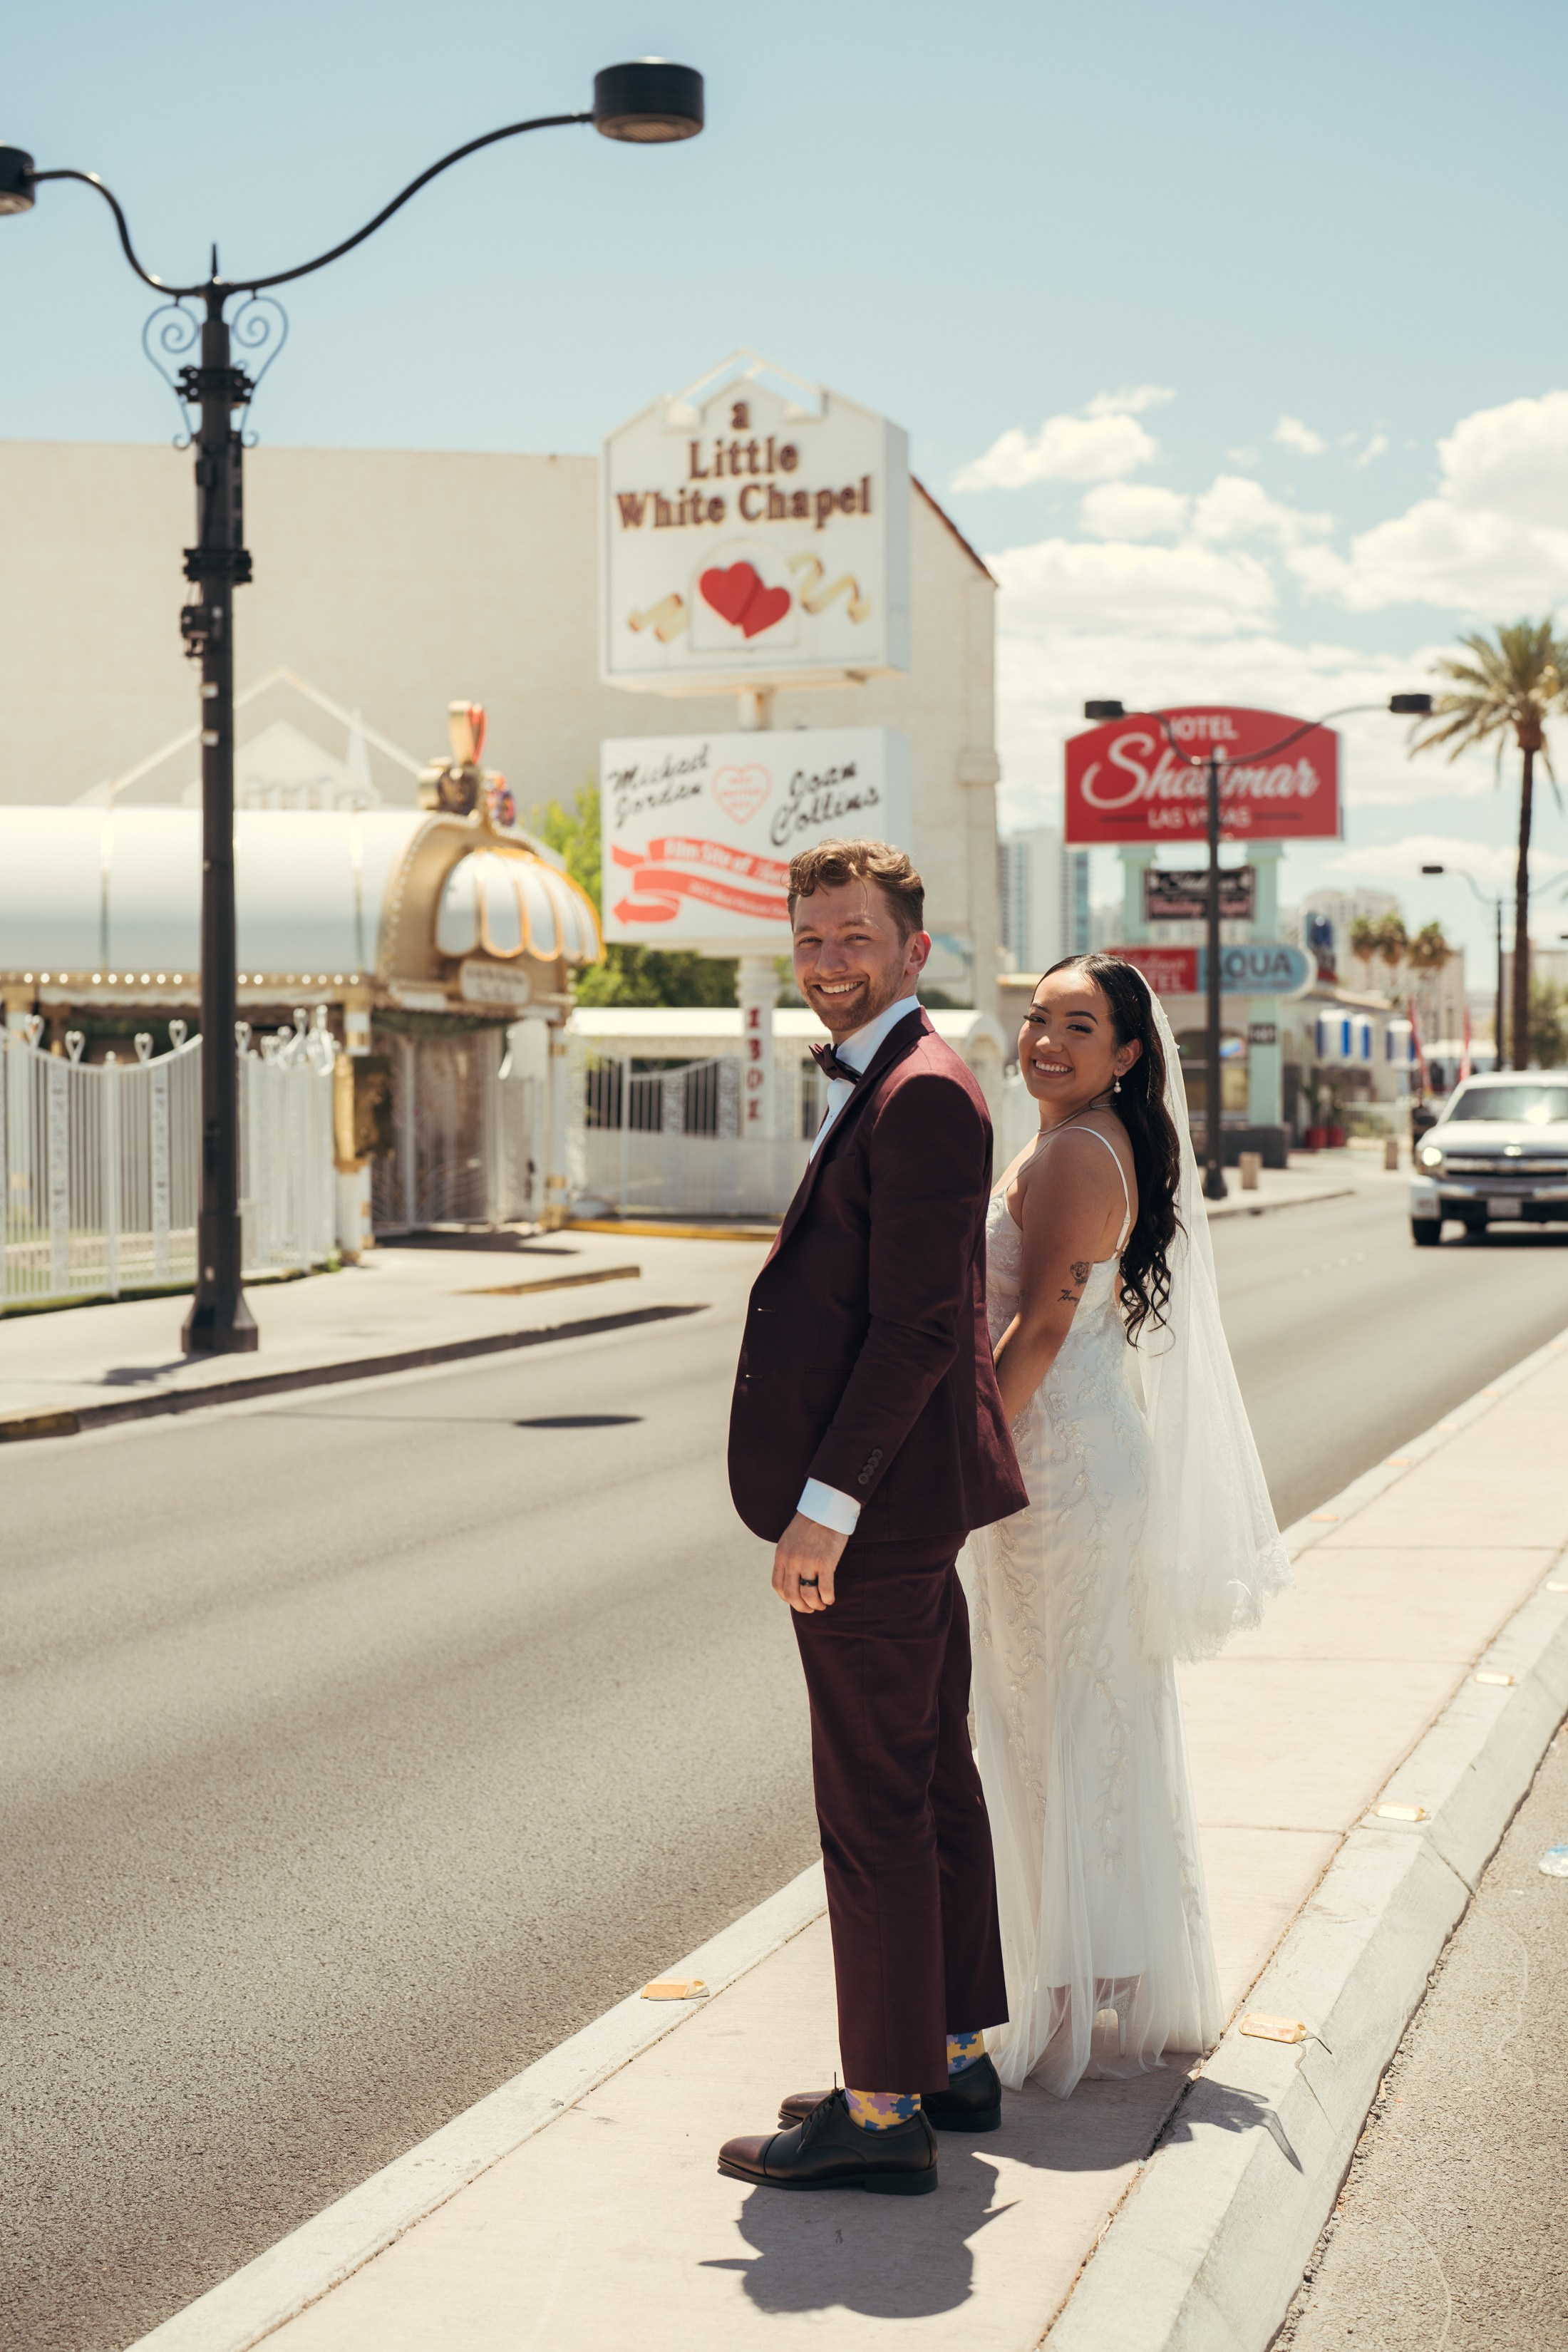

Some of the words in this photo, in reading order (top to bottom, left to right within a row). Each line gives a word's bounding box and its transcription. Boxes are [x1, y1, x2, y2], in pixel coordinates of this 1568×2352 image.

[732, 401, 750, 430] a
[688, 436, 799, 479] Little
[617, 488, 726, 528] White
[739, 475, 870, 530] Chapel
[1160, 716, 1239, 741] HOTEL
[770, 788, 879, 846] Collins
[1147, 807, 1184, 830] LAS
[664, 839, 699, 857] Film
[701, 842, 731, 866] Site
[732, 855, 753, 872] of
[1207, 950, 1292, 979] QUA
